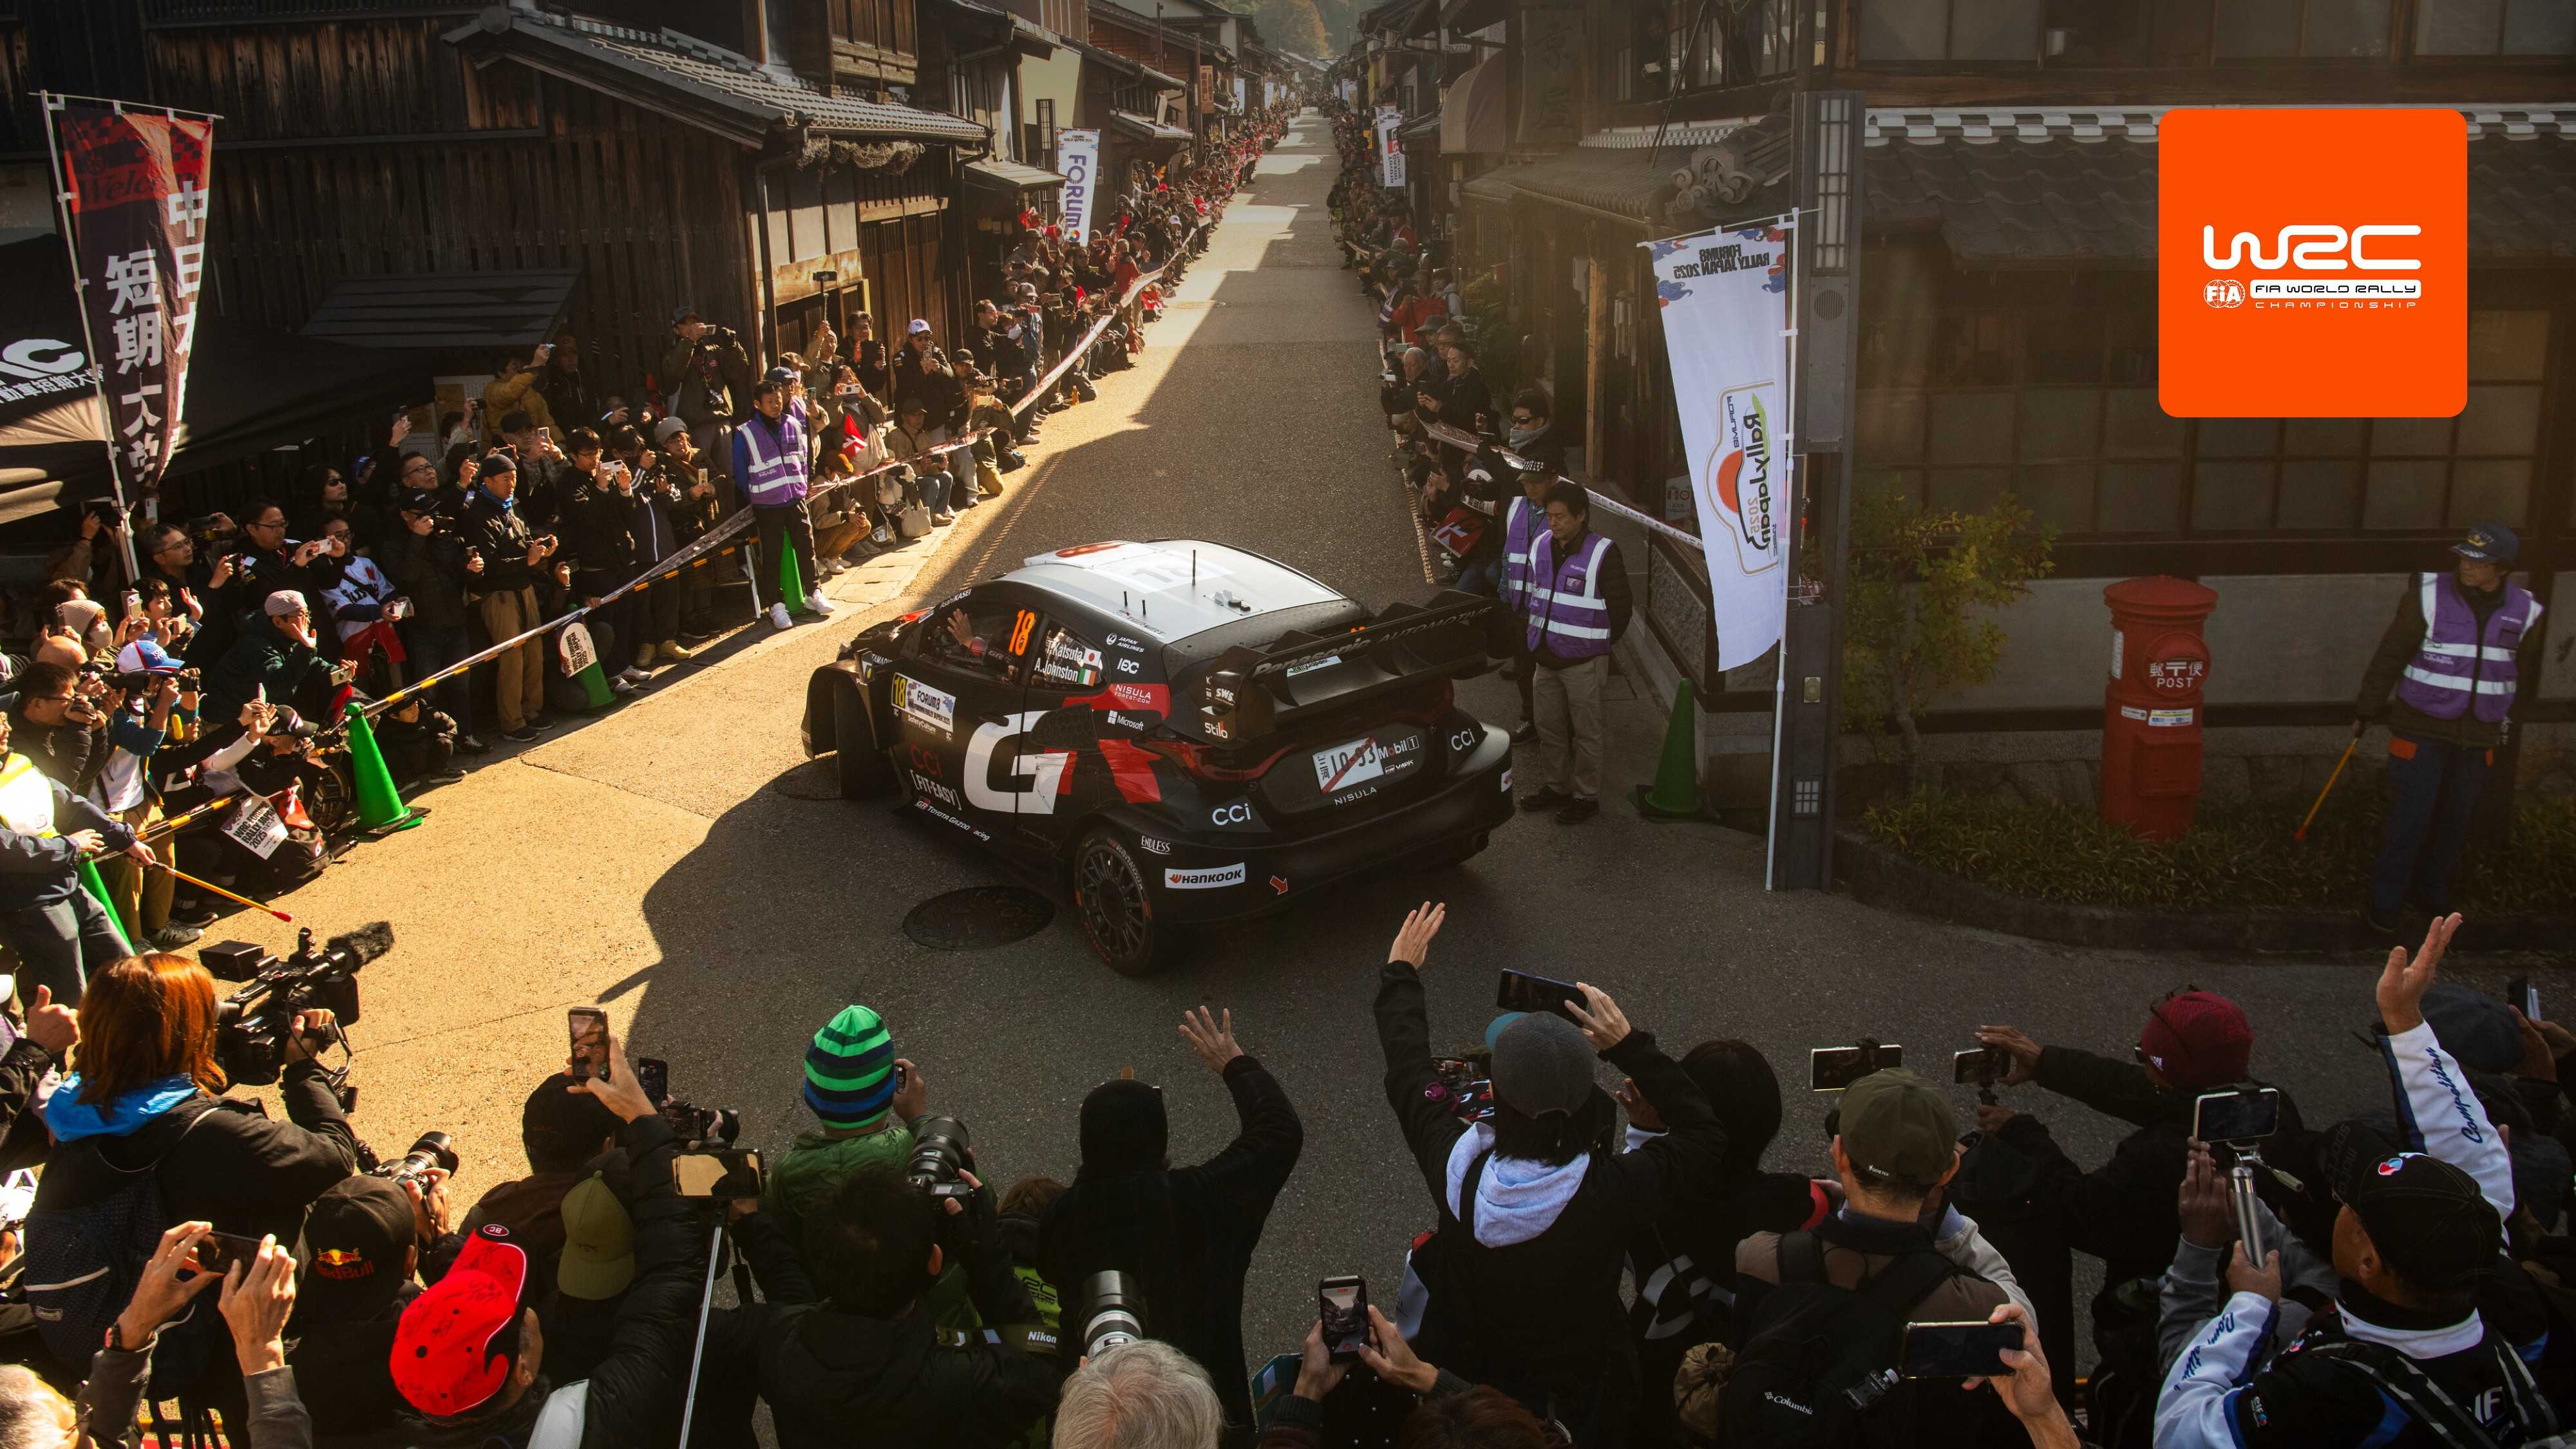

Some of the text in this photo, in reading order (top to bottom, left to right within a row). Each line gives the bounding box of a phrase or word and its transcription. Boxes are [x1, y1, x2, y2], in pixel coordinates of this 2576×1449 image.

[1009, 609, 1037, 657] 18
[1117, 643, 1144, 653] AIRLINES
[1252, 638, 1372, 677] Panasonic
[893, 676, 906, 707] 18
[2157, 677, 2193, 688] POST
[1115, 684, 1151, 700] NISULA
[1117, 715, 1144, 731] Microsoft
[1204, 721, 1228, 739] Stilo
[1378, 739, 1408, 760] Mobil
[1334, 787, 1377, 806] NISULA
[927, 806, 949, 820] TOYOTA
[1212, 802, 1251, 826] CCi
[249, 830, 268, 849] 2025
[1141, 835, 1171, 853] ENDLESS
[2425, 1046, 2483, 1144] Competition
[1028, 1331, 1057, 1344] Nikon
